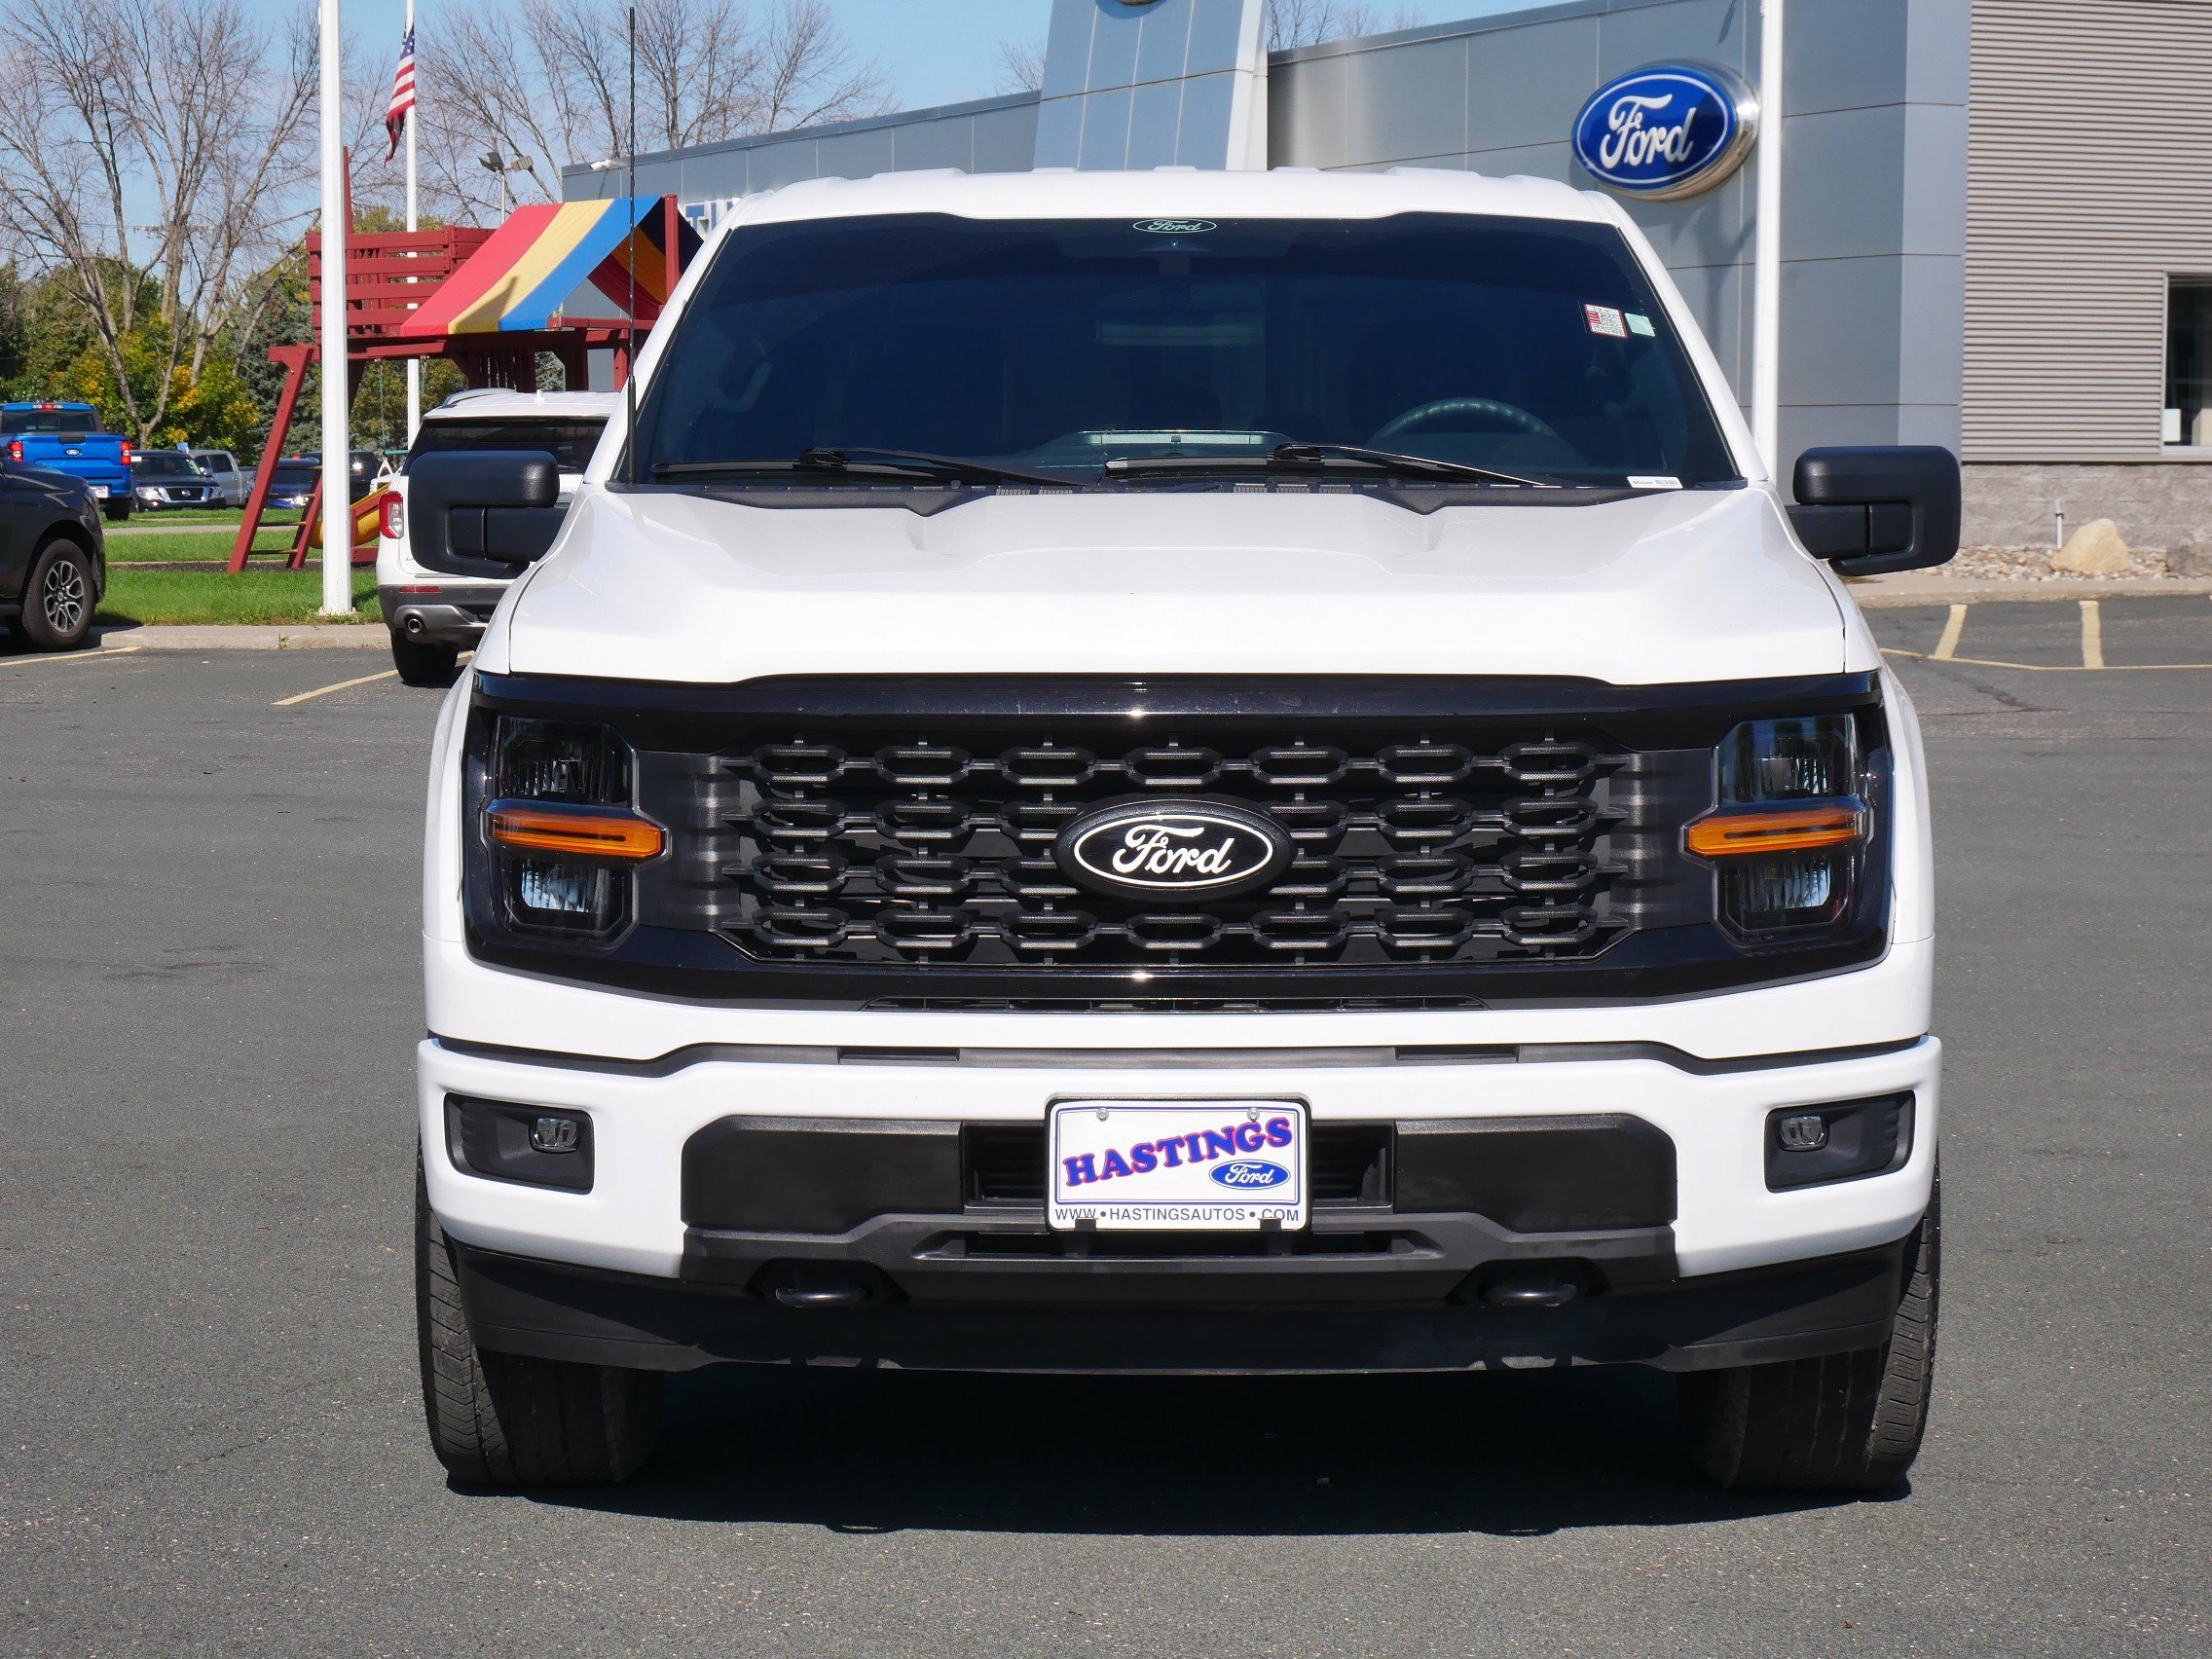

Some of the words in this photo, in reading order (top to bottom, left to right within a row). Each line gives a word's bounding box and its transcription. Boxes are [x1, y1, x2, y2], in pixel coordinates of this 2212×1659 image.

[1599, 93, 1697, 169] Ford
[1147, 218, 1202, 231] Ford
[1112, 825, 1235, 874] Ford
[1062, 1117, 1293, 1187] HASTINGS
[1224, 1162, 1273, 1185] Ford
